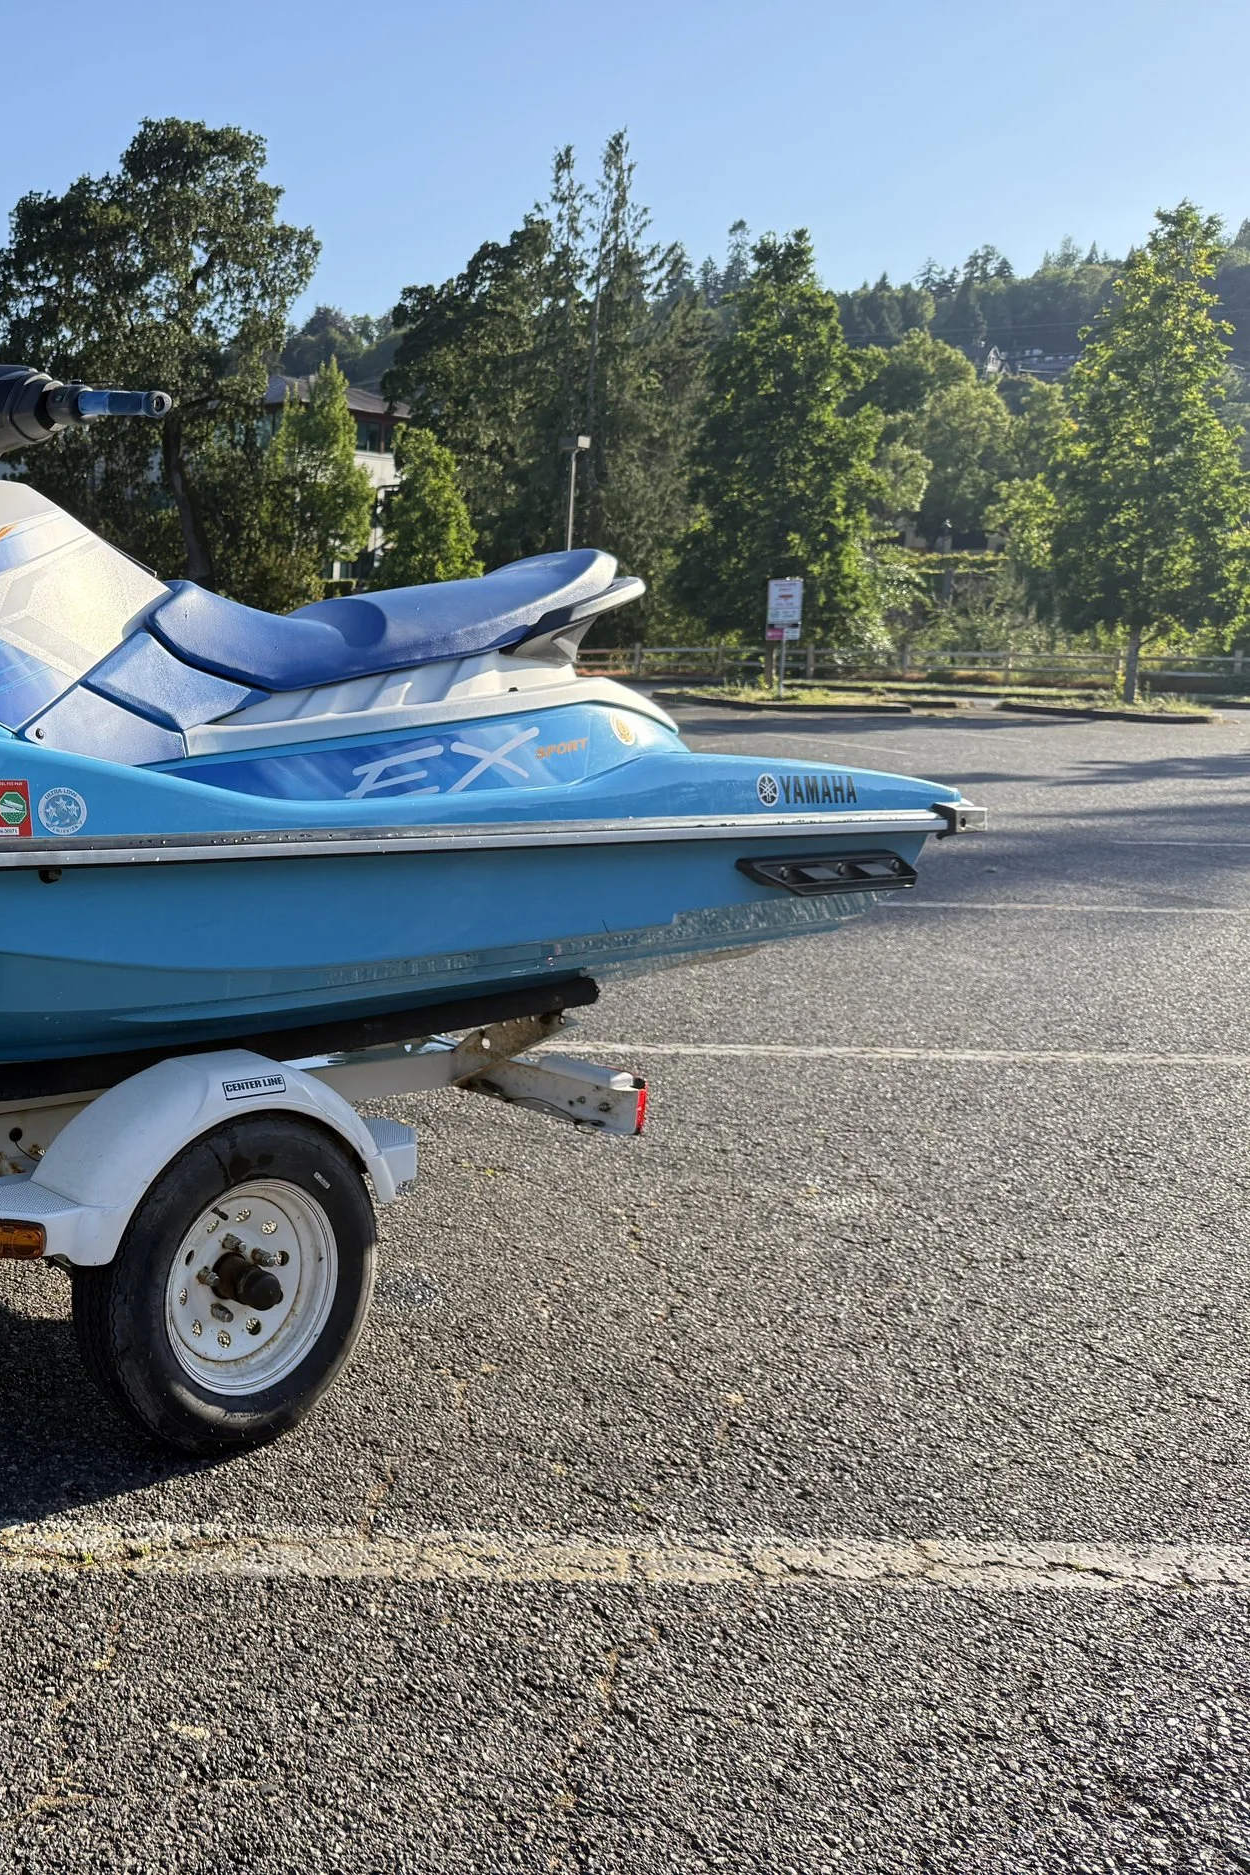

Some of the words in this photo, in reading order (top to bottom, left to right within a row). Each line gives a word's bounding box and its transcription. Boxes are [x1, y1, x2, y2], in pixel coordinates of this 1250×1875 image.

[345, 726, 540, 799] EX
[779, 775, 858, 804] YAMAHA
[225, 1079, 262, 1092] CENTER
[262, 1076, 284, 1087] LINE
